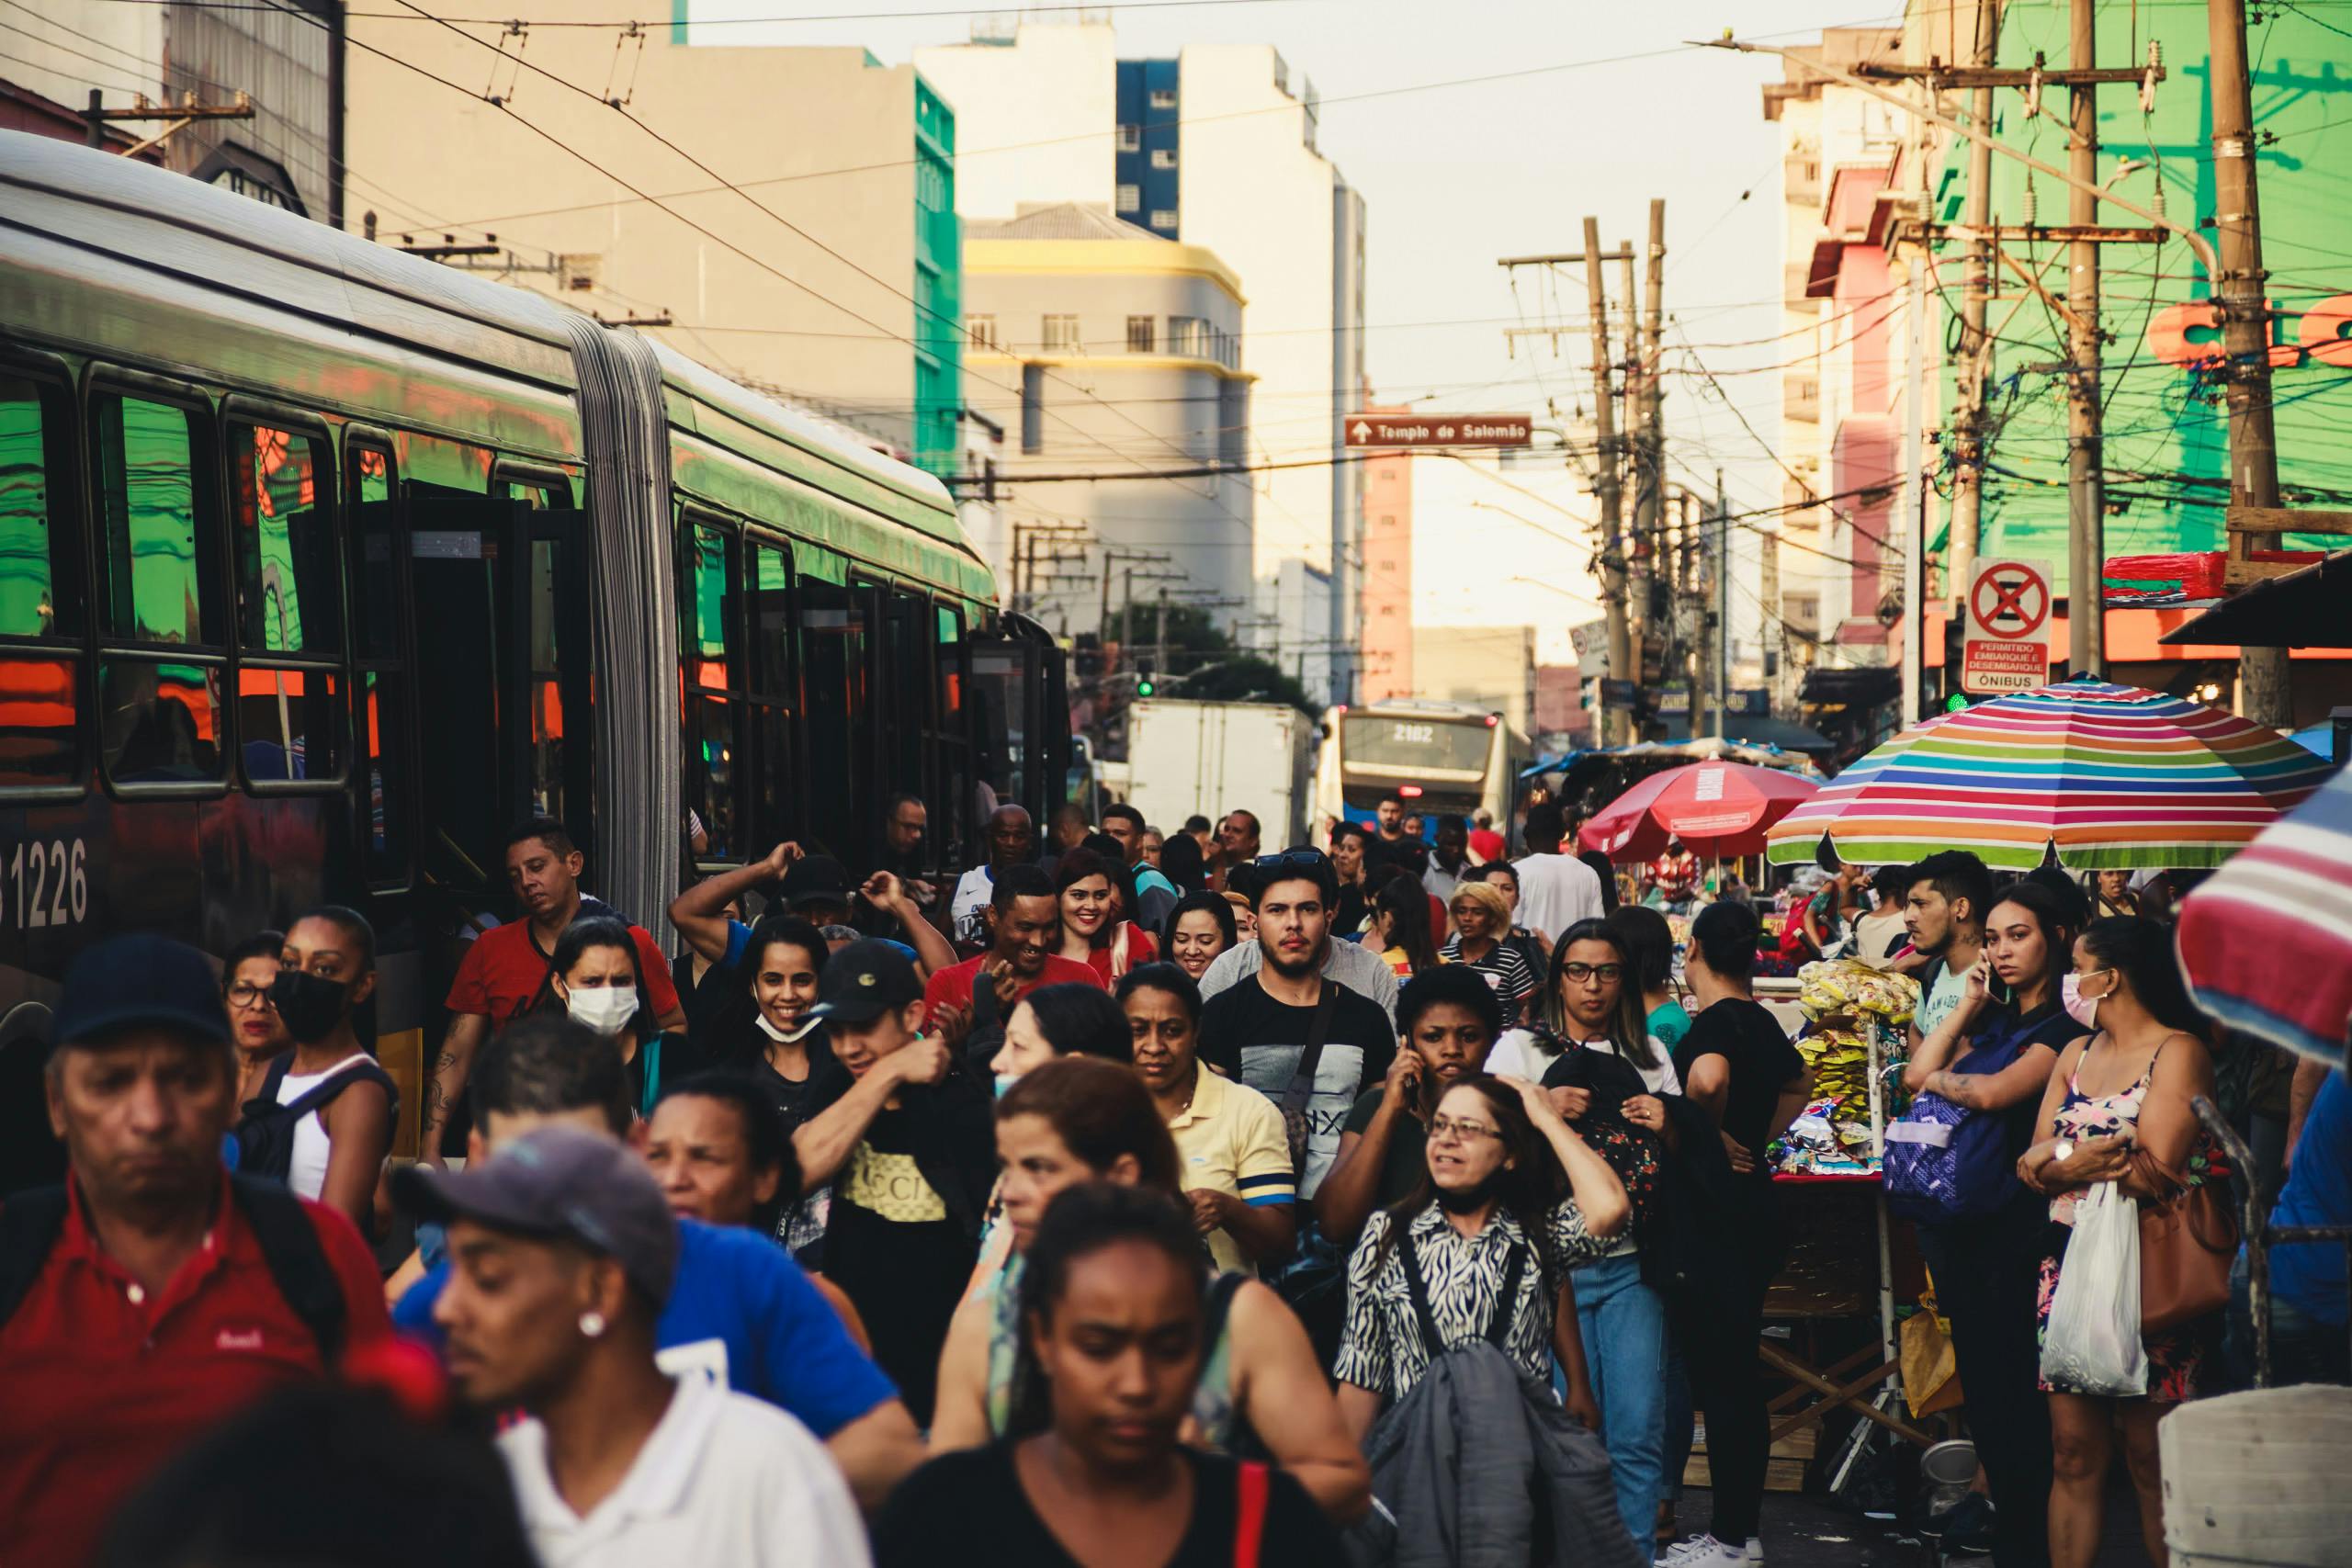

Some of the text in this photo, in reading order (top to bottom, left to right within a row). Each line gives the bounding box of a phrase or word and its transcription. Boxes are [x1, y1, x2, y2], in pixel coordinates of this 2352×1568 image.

[1378, 423, 1527, 441] Templo de Salomão
[1980, 642, 2034, 653] PERMITIDO
[1974, 652, 2039, 662] EMBARQUE E
[1968, 661, 2044, 672] DESEMBARQUE
[1979, 672, 2032, 687] ÔNIBUS
[0, 838, 86, 929] 1226
